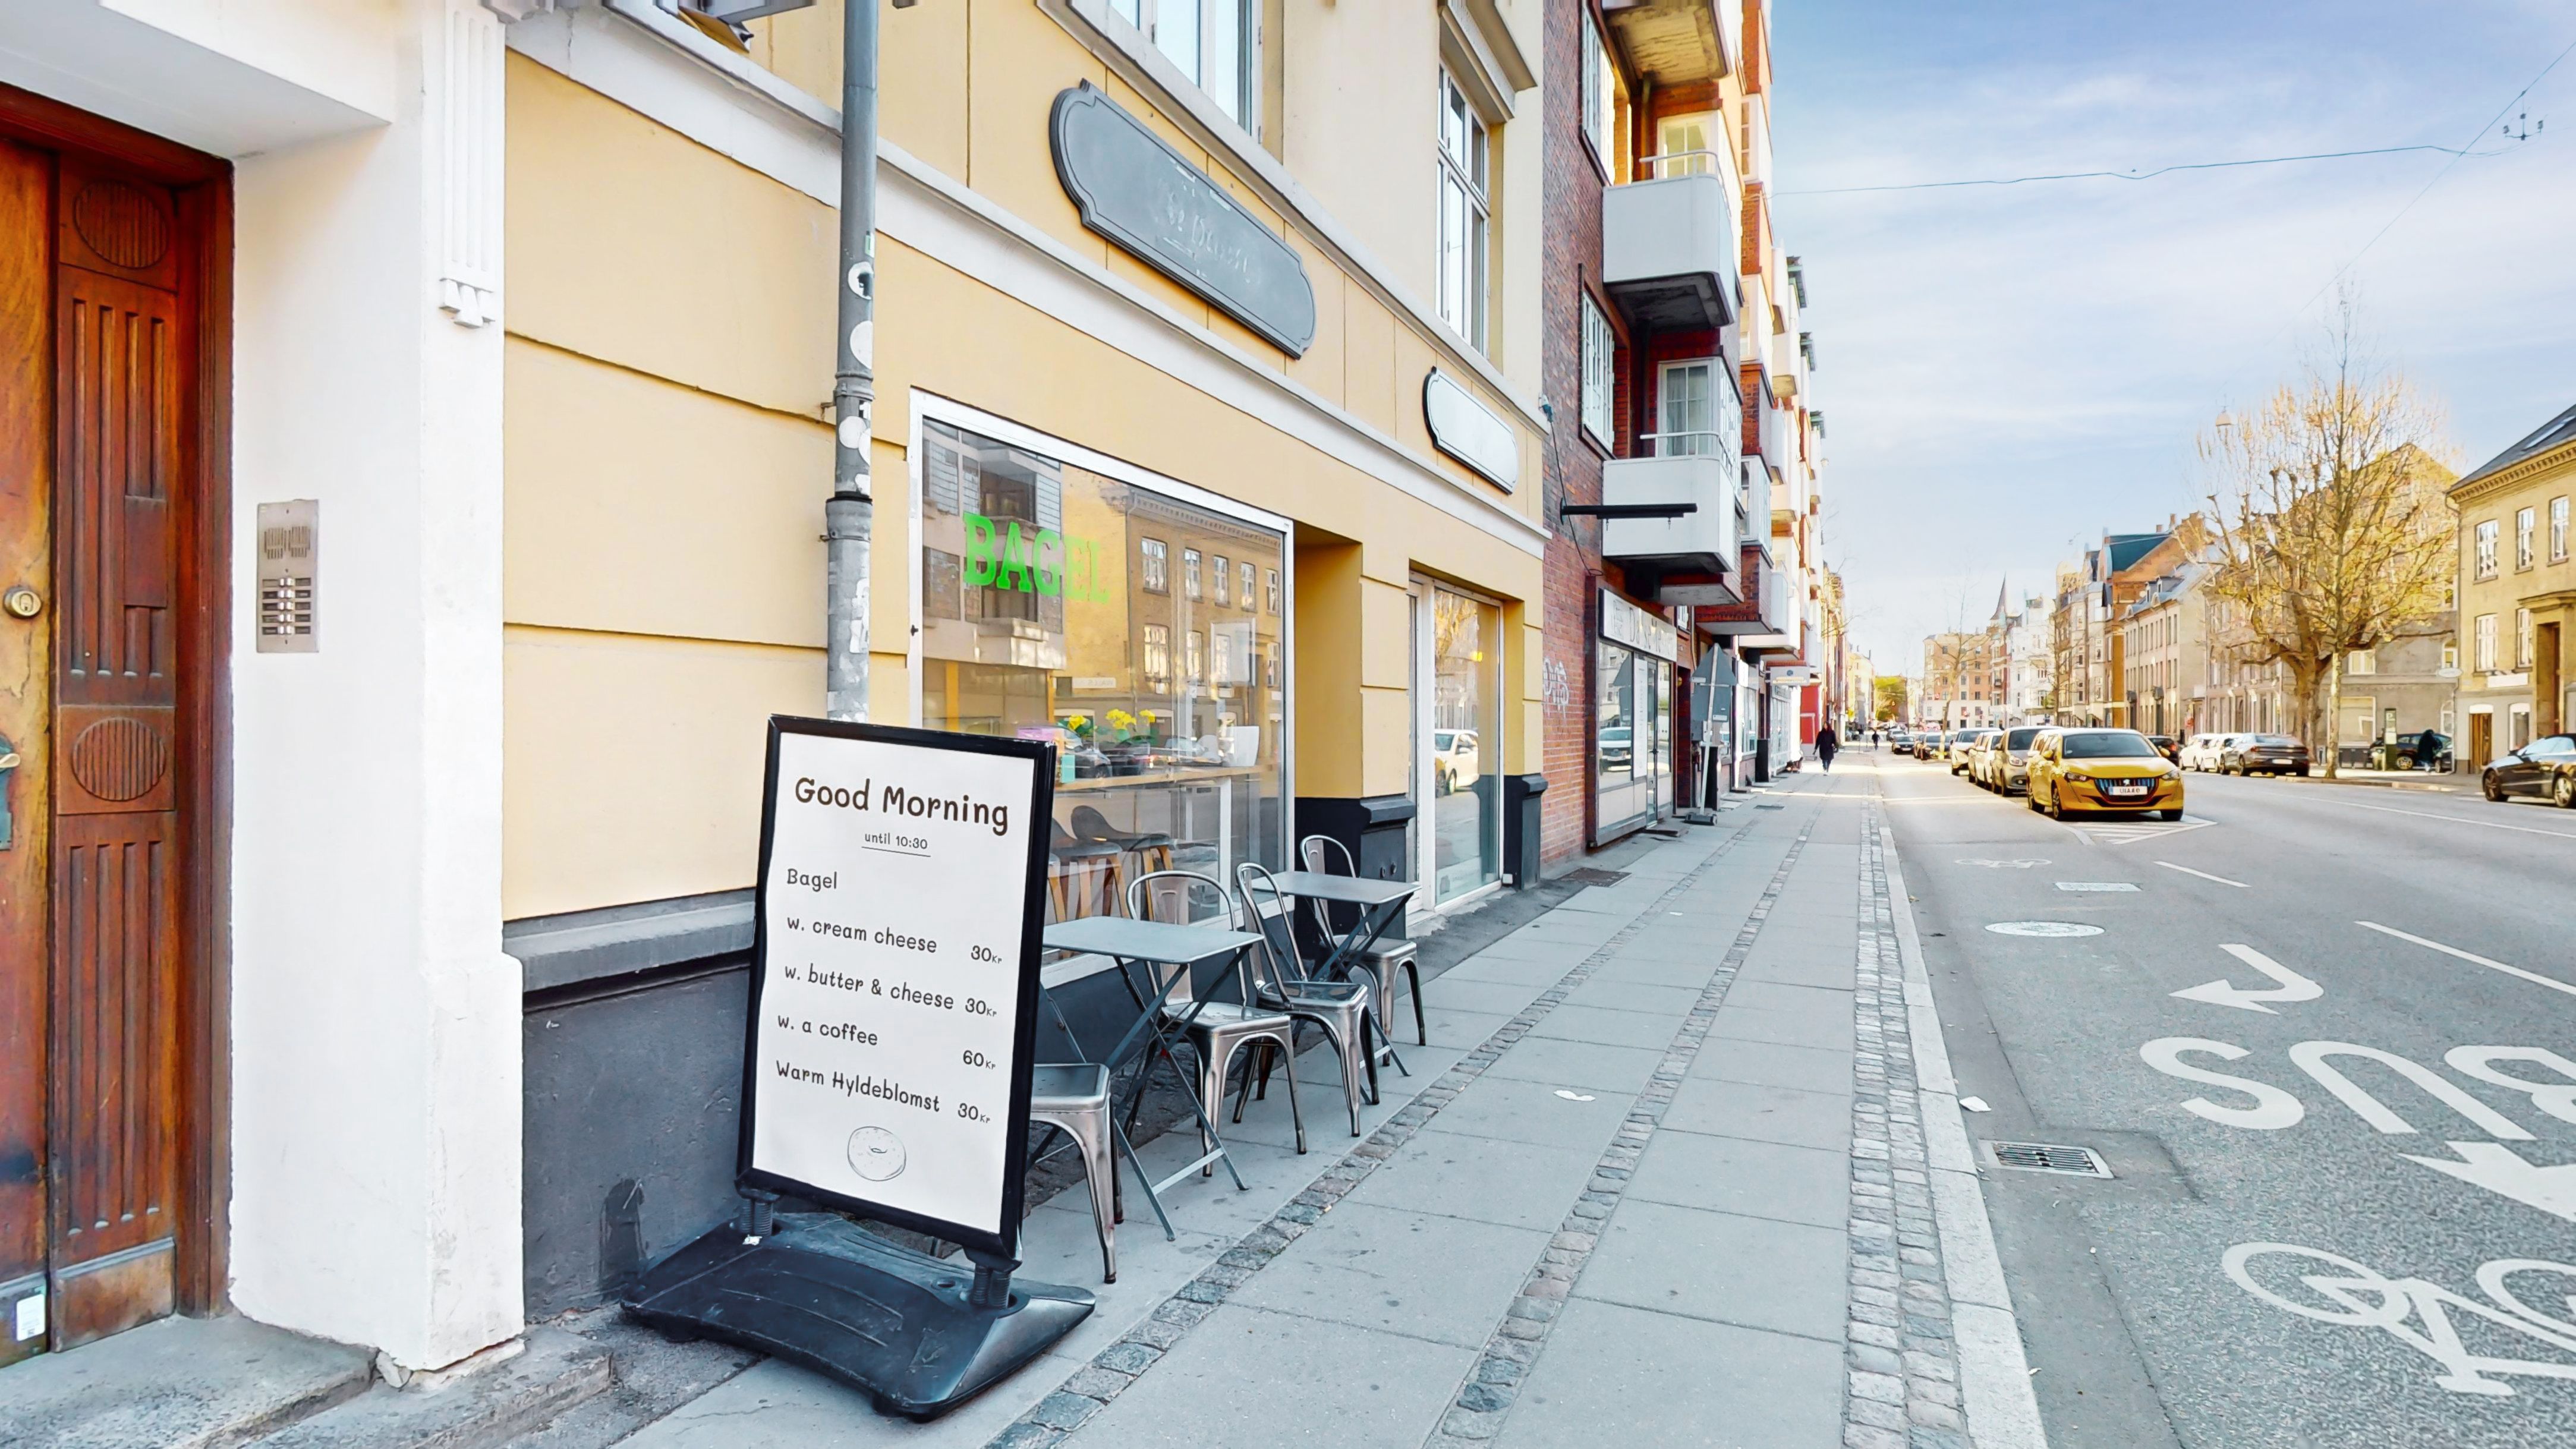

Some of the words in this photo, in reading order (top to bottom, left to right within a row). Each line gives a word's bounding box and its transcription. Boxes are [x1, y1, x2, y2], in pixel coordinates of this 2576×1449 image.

[963, 511, 1110, 604] BAGEL
[795, 777, 871, 811] Good
[882, 785, 1008, 837] Morning
[865, 832, 890, 845] until
[895, 835, 928, 850] 10:30
[786, 868, 837, 893] Bagel
[787, 917, 805, 931] w.
[813, 921, 867, 941] cream
[874, 927, 937, 953] cheese
[785, 966, 801, 981] w.
[807, 962, 864, 992] butter
[871, 978, 882, 996] &
[890, 981, 954, 1010] cheese
[777, 1015, 795, 1030] w.
[802, 1021, 812, 1034] a
[819, 1022, 878, 1046] coffee
[776, 1060, 824, 1085] Warm
[832, 1071, 940, 1113] Hyldeblomst
